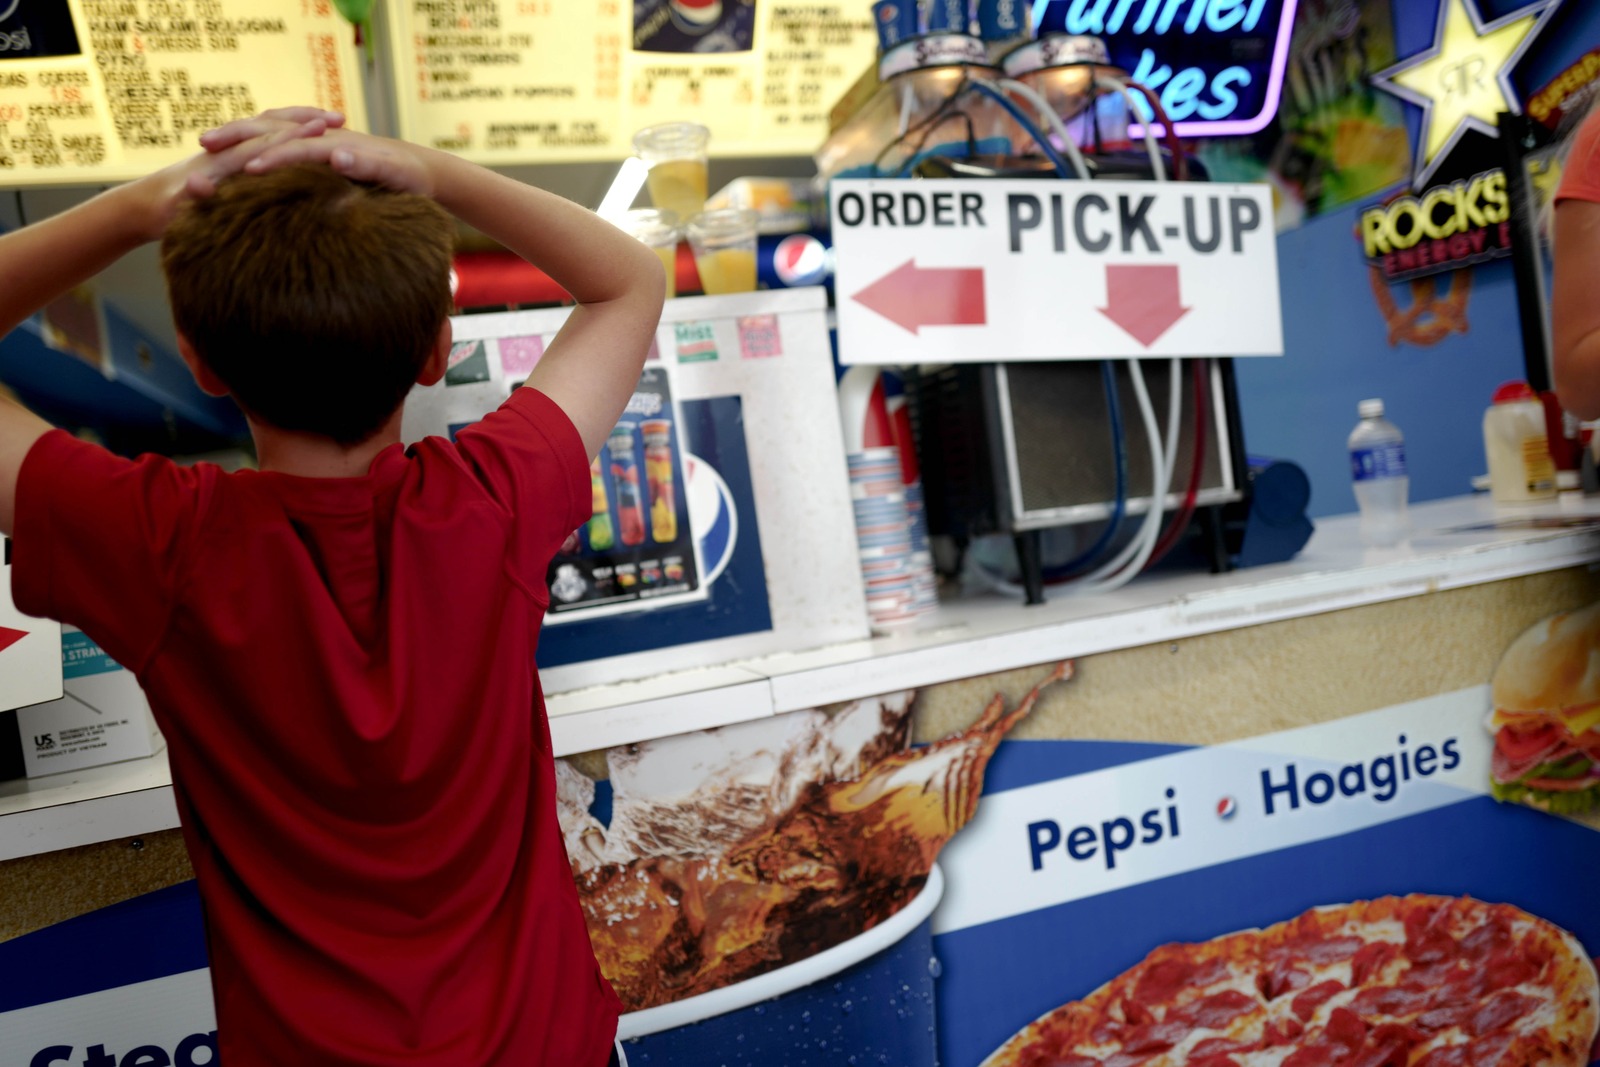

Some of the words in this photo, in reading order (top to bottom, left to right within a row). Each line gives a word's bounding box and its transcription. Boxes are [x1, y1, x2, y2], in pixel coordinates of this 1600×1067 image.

[1125, 49, 1252, 121] kes
[838, 191, 987, 227] ORDER
[1007, 193, 1262, 254] PICK-UP
[1361, 171, 1510, 257] ROCKS
[1027, 788, 1181, 872] Pepsi
[1260, 734, 1462, 816] Hoagies
